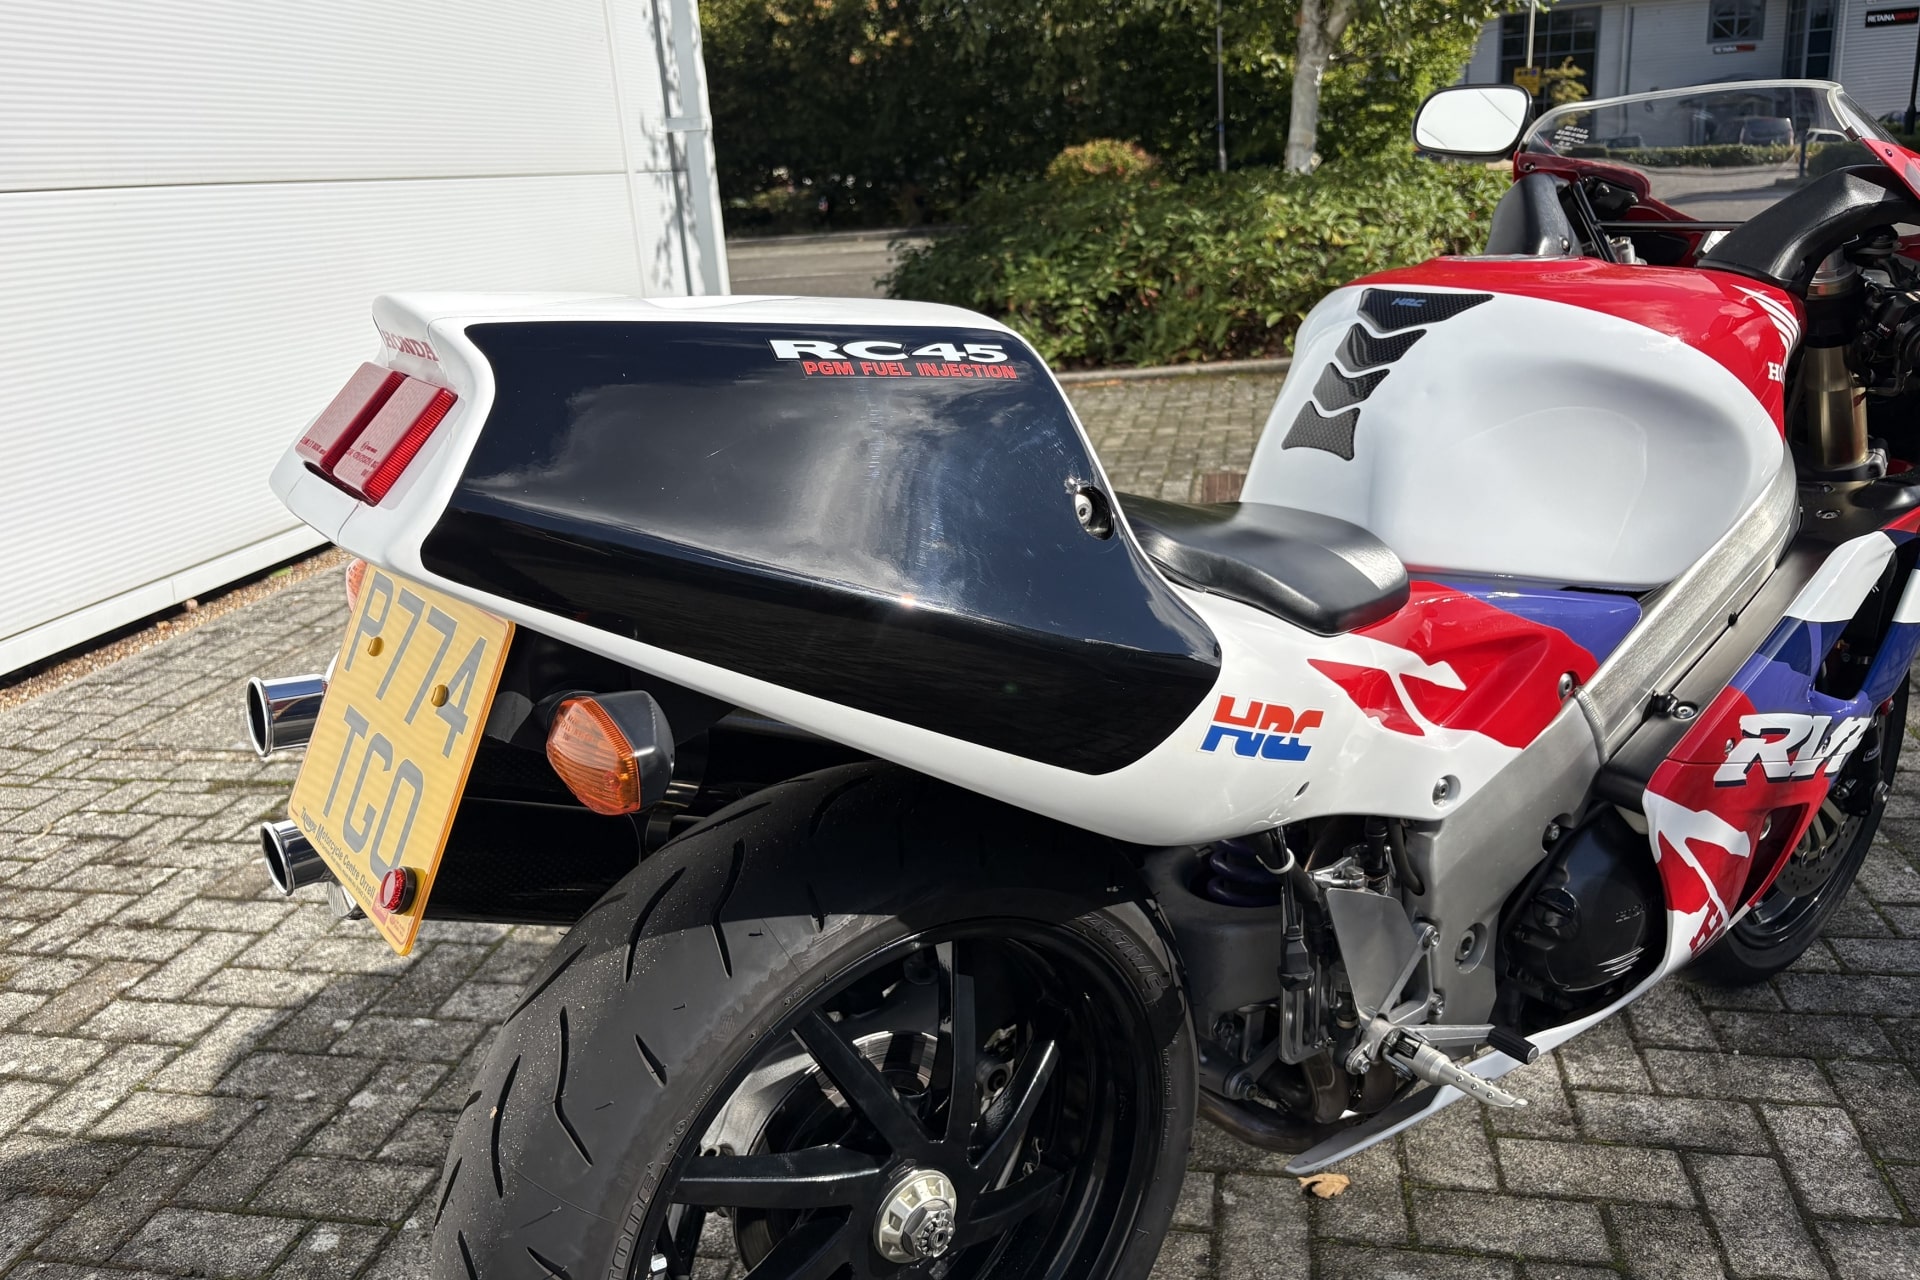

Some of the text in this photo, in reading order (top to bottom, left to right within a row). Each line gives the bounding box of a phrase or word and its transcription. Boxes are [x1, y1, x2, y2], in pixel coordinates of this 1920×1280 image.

[1391, 297, 1427, 308] HRC
[380, 330, 439, 362] HONDA
[768, 339, 1009, 363] RC45
[803, 361, 1018, 379] PGM FUEL INJECTION
[344, 570, 488, 759] P774
[1199, 694, 1325, 762] HRC
[322, 704, 425, 881] TGO
[315, 823, 377, 899] Motorcycle Centre Orrell
